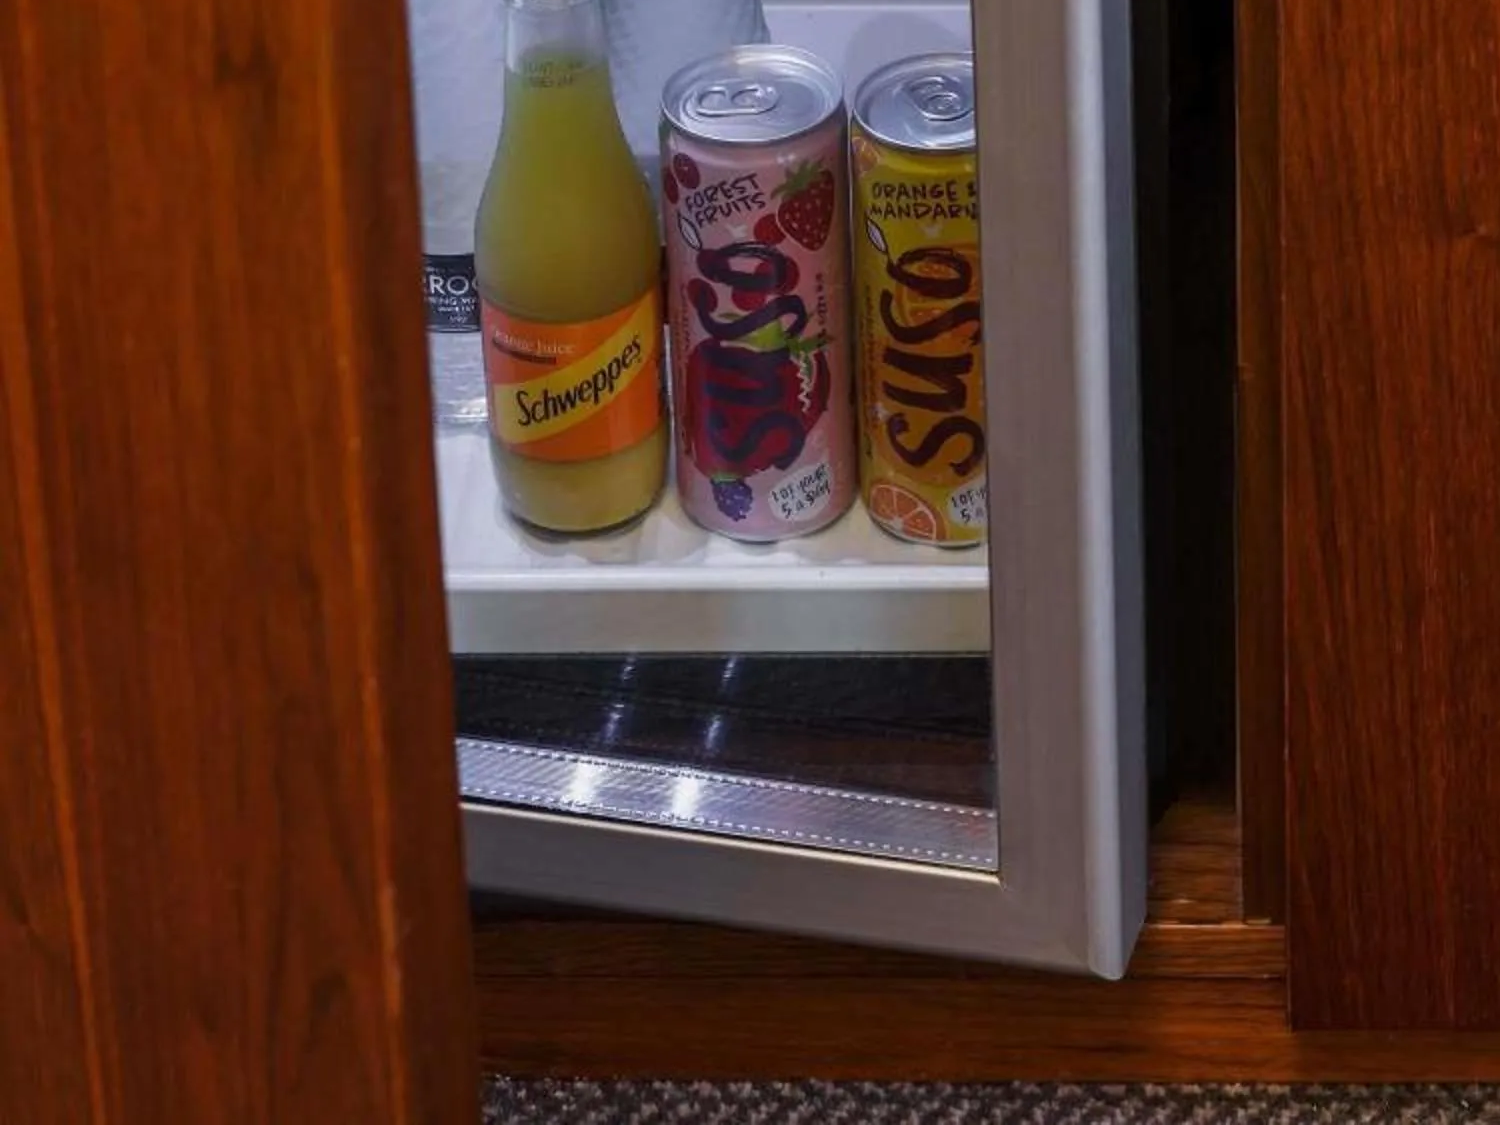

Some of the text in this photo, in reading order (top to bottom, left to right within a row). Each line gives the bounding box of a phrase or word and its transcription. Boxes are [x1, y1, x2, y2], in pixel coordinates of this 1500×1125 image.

[685, 173, 761, 211] FOREST
[695, 192, 766, 227] FRUITS
[871, 180, 958, 201] ORANGE
[516, 334, 642, 427] Schweppes
[696, 241, 808, 472] SUSO
[880, 246, 986, 477] SUSO
